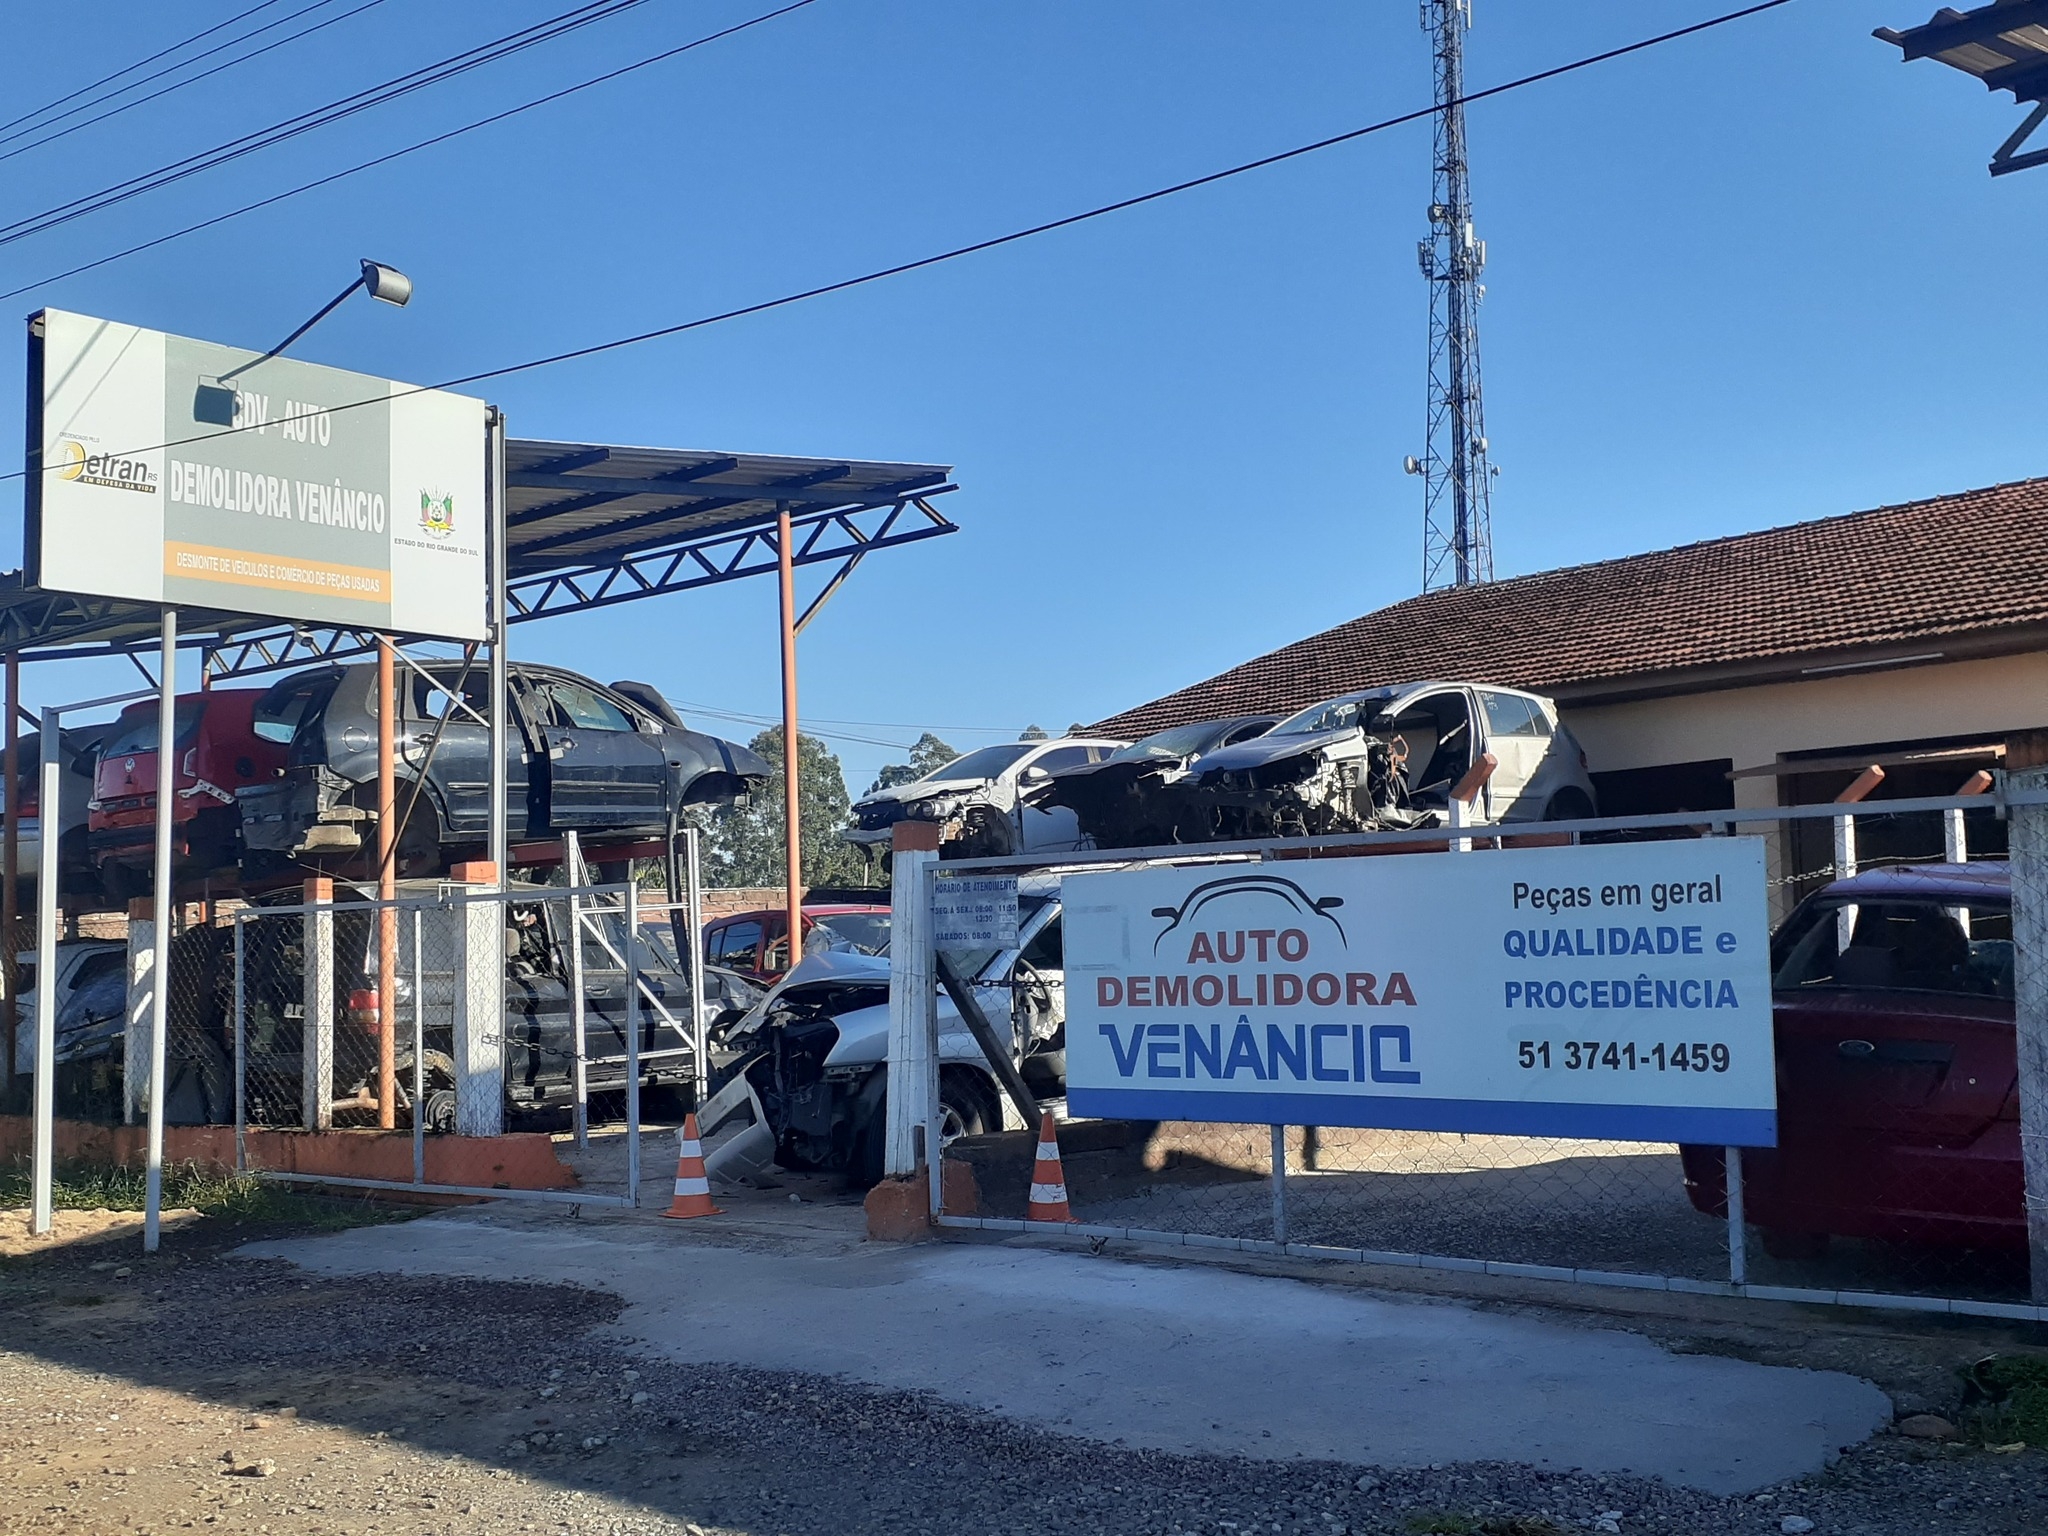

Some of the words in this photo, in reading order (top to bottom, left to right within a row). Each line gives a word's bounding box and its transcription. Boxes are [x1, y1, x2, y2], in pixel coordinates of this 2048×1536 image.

[232, 390, 268, 435] CDV
[283, 400, 331, 447] AUTO
[58, 441, 148, 482] Detran
[96, 478, 123, 488] DEFESA
[125, 482, 135, 490] DA
[137, 484, 154, 492] VIDA
[170, 459, 292, 520] DEMOLIDORA
[295, 478, 385, 534] VENÂNCIO
[394, 538, 416, 547] ESTADO
[426, 542, 436, 550] RIO
[437, 544, 459, 554] GRANDE
[468, 549, 479, 557] SUL
[176, 552, 219, 572] DESMONTE
[219, 557, 231, 573] DE
[231, 557, 269, 578] VEÍCULOS
[269, 564, 275, 579] E
[276, 564, 314, 584] COMÉRCIO
[315, 571, 326, 585] DE
[326, 572, 351, 591] PEÇAS
[351, 575, 380, 593] USADAS
[963, 882, 971, 893] DE
[973, 880, 1017, 892] ATENDIMENTO
[1513, 882, 1592, 915] Peças
[1600, 882, 1641, 906] em
[1651, 874, 1722, 912] geral
[972, 931, 992, 940] 08:00
[1187, 928, 1309, 964] AUTO
[1503, 926, 1703, 959] QUALIDADE
[1715, 931, 1737, 954] e
[1097, 972, 1418, 1007] DEMOLIDORA
[1505, 973, 1739, 1008] PROCEDÊNCIA
[1098, 1014, 1421, 1084] VENÂNCIO
[1518, 1041, 1551, 1068] 51
[1564, 1041, 1730, 1073] 3741-1459
